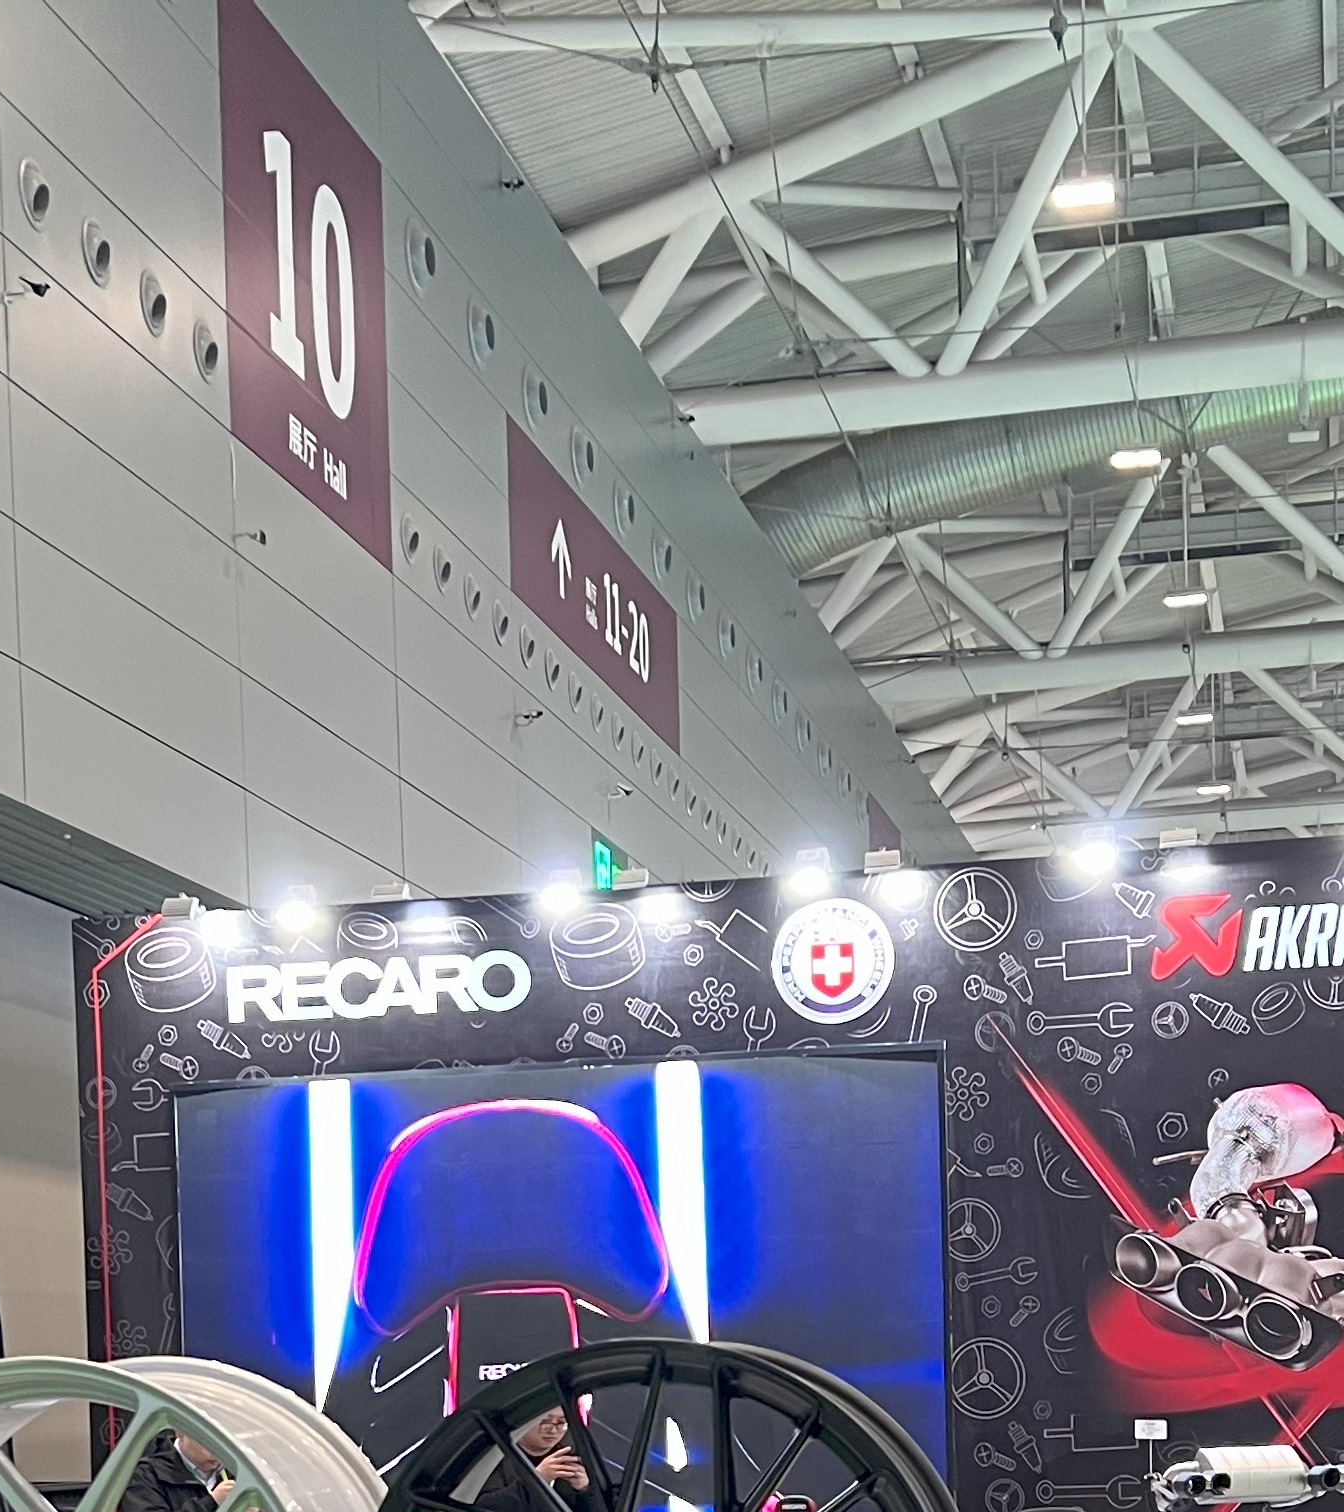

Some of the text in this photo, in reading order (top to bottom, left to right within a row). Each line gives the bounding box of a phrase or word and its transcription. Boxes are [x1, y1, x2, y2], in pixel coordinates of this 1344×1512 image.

[263, 131, 355, 420] 10
[289, 413, 347, 500] 展厅 Hall
[604, 573, 650, 684] 11-20
[227, 949, 532, 1024] RECARO
